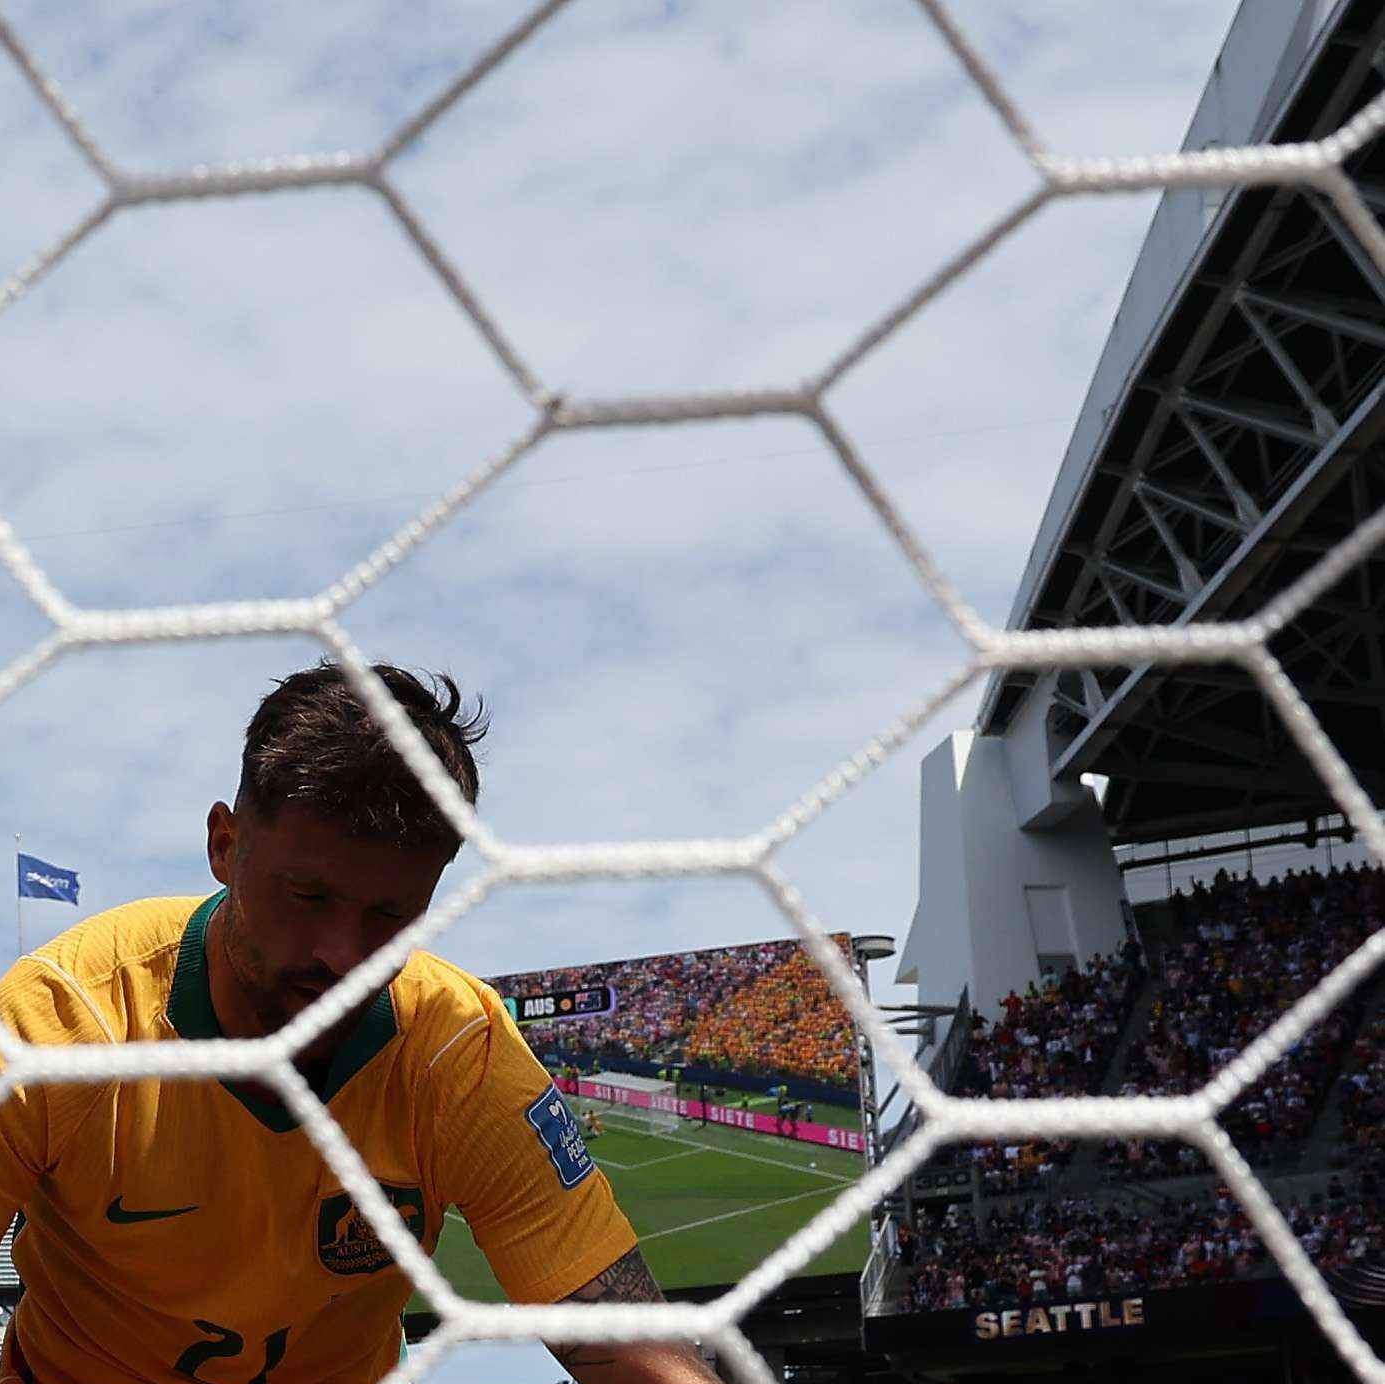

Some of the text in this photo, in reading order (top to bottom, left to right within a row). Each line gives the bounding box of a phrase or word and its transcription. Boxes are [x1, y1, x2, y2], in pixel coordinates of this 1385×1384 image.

[523, 996, 556, 1018] AUS
[710, 1103, 755, 1128] SIETE
[975, 1299, 1145, 1340] SEATTLE
